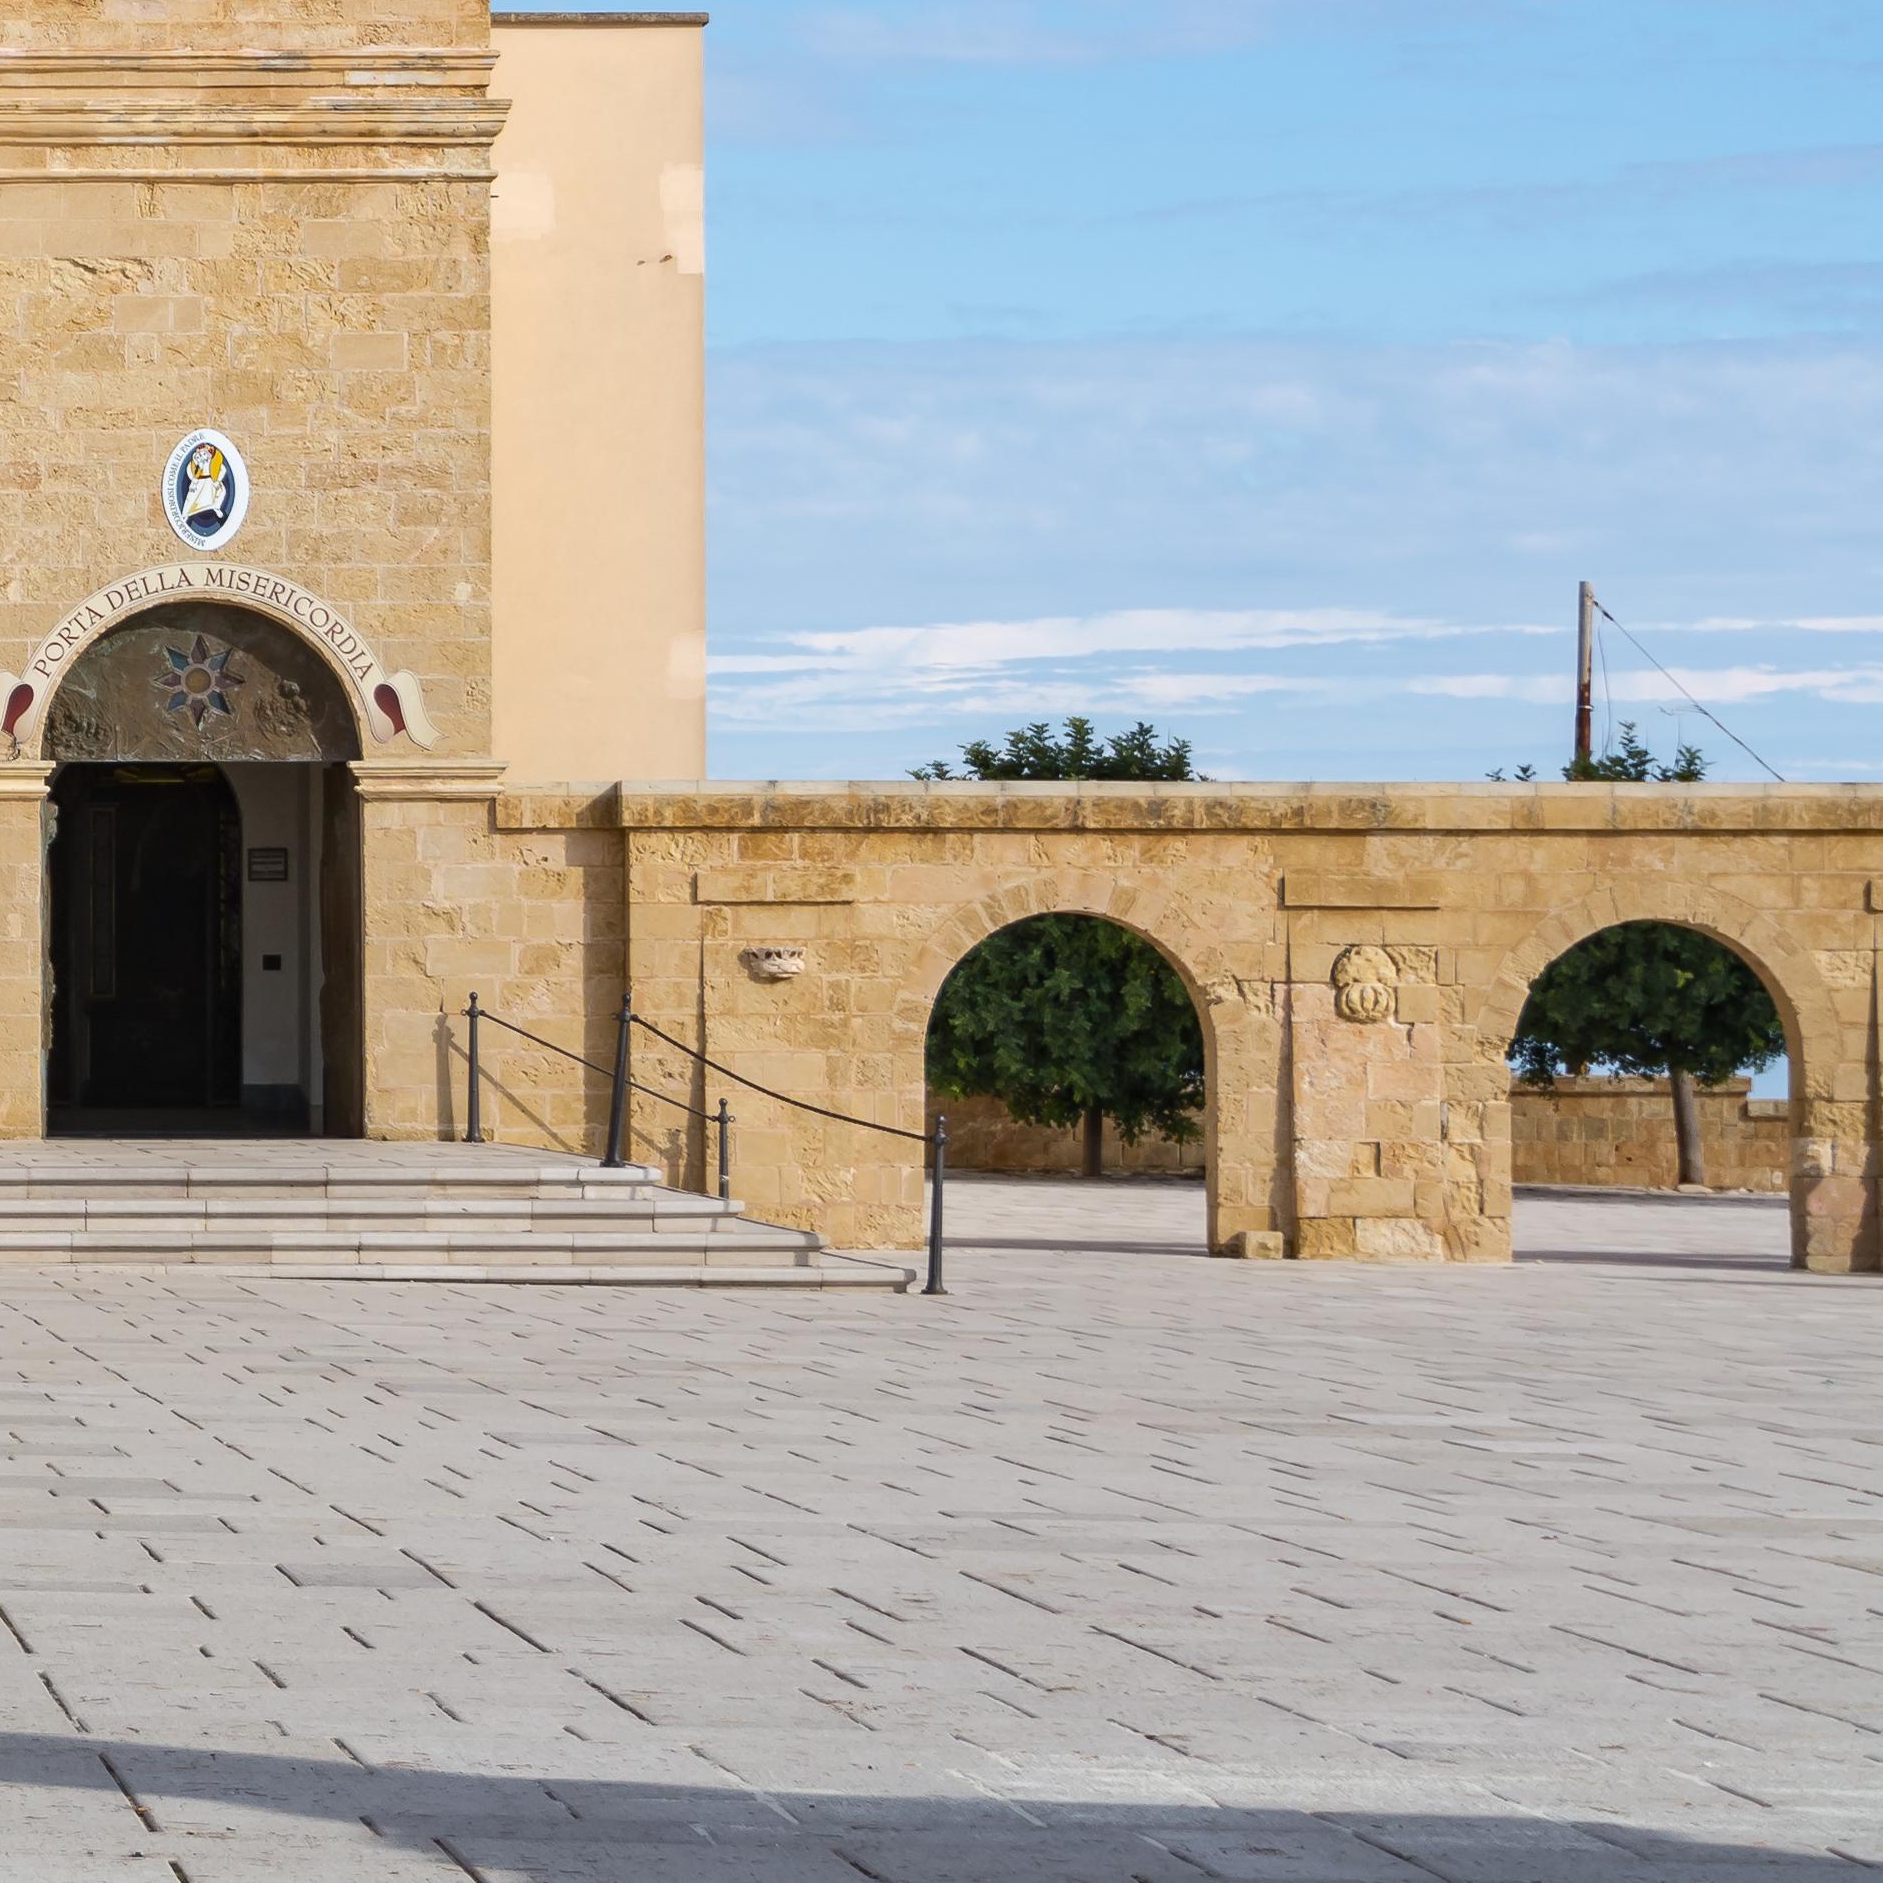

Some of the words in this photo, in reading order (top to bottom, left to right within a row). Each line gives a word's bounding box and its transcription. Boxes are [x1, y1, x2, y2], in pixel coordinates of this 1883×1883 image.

[168, 466, 178, 487] COME
[32, 606, 104, 680] PORTA
[105, 567, 196, 613] DELLA
[204, 568, 377, 683] MISERICORDIA
